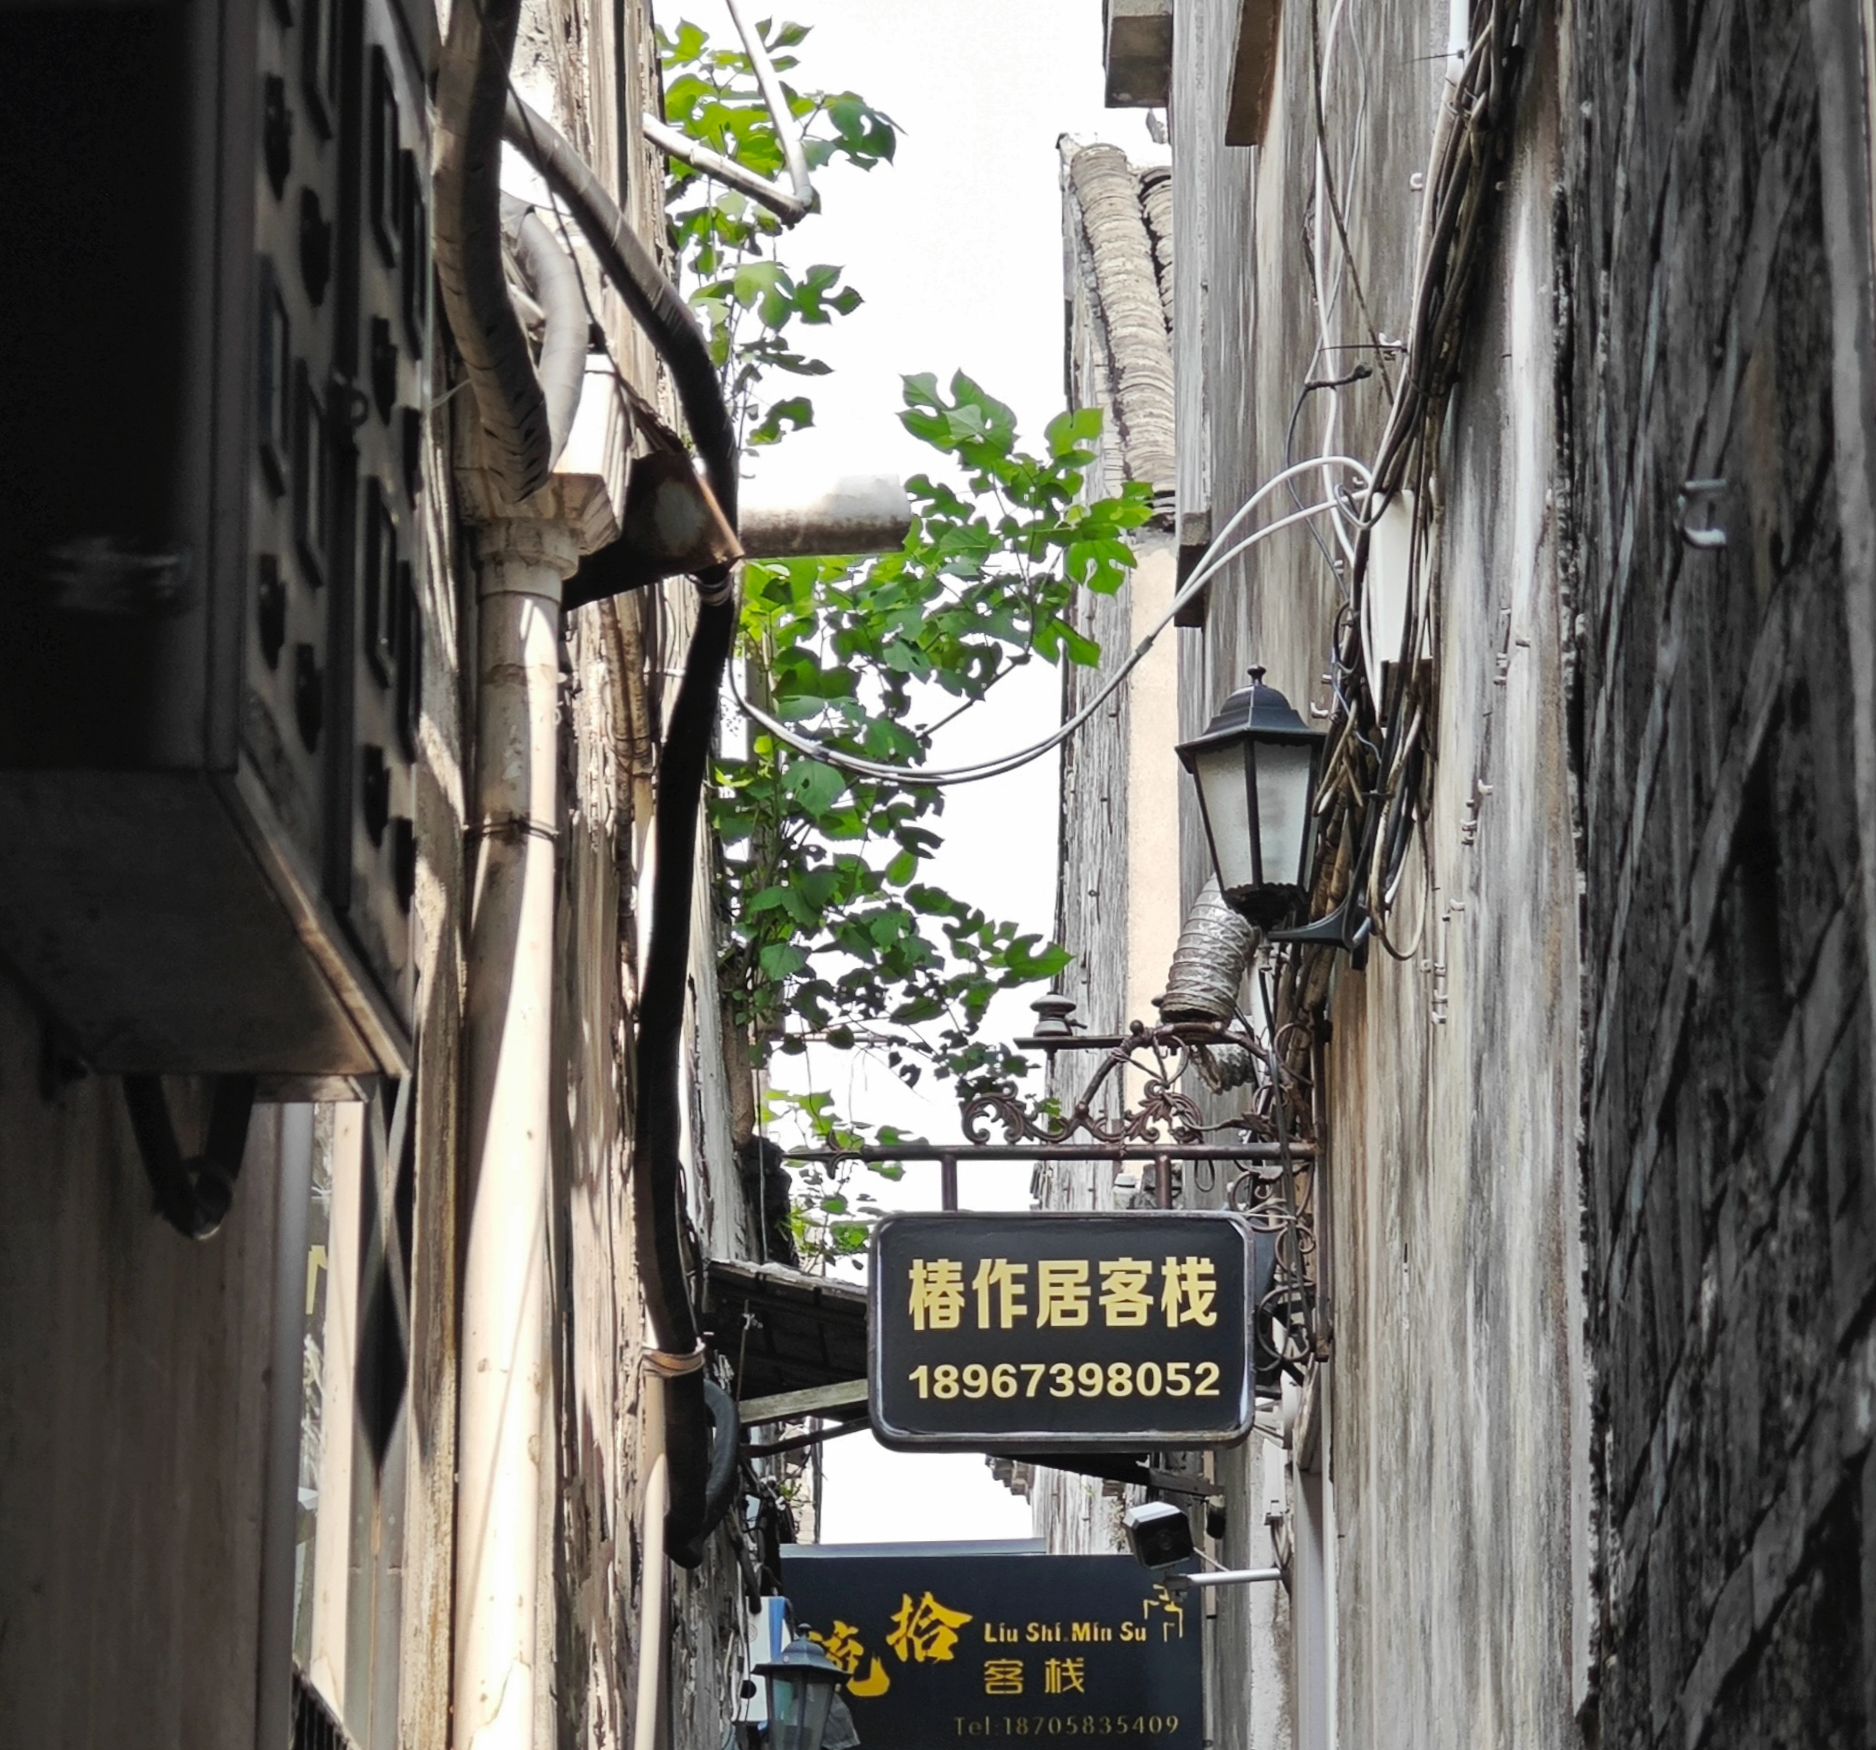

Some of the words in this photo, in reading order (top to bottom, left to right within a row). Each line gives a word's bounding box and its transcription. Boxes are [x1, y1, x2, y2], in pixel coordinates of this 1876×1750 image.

[908, 1256, 1218, 1331] 椿作居客栈
[908, 1361, 1220, 1400] 18967398052
[984, 1621, 1019, 1643] Liu
[1119, 1620, 1147, 1642] Su
[984, 1658, 1086, 1695] 客栈
